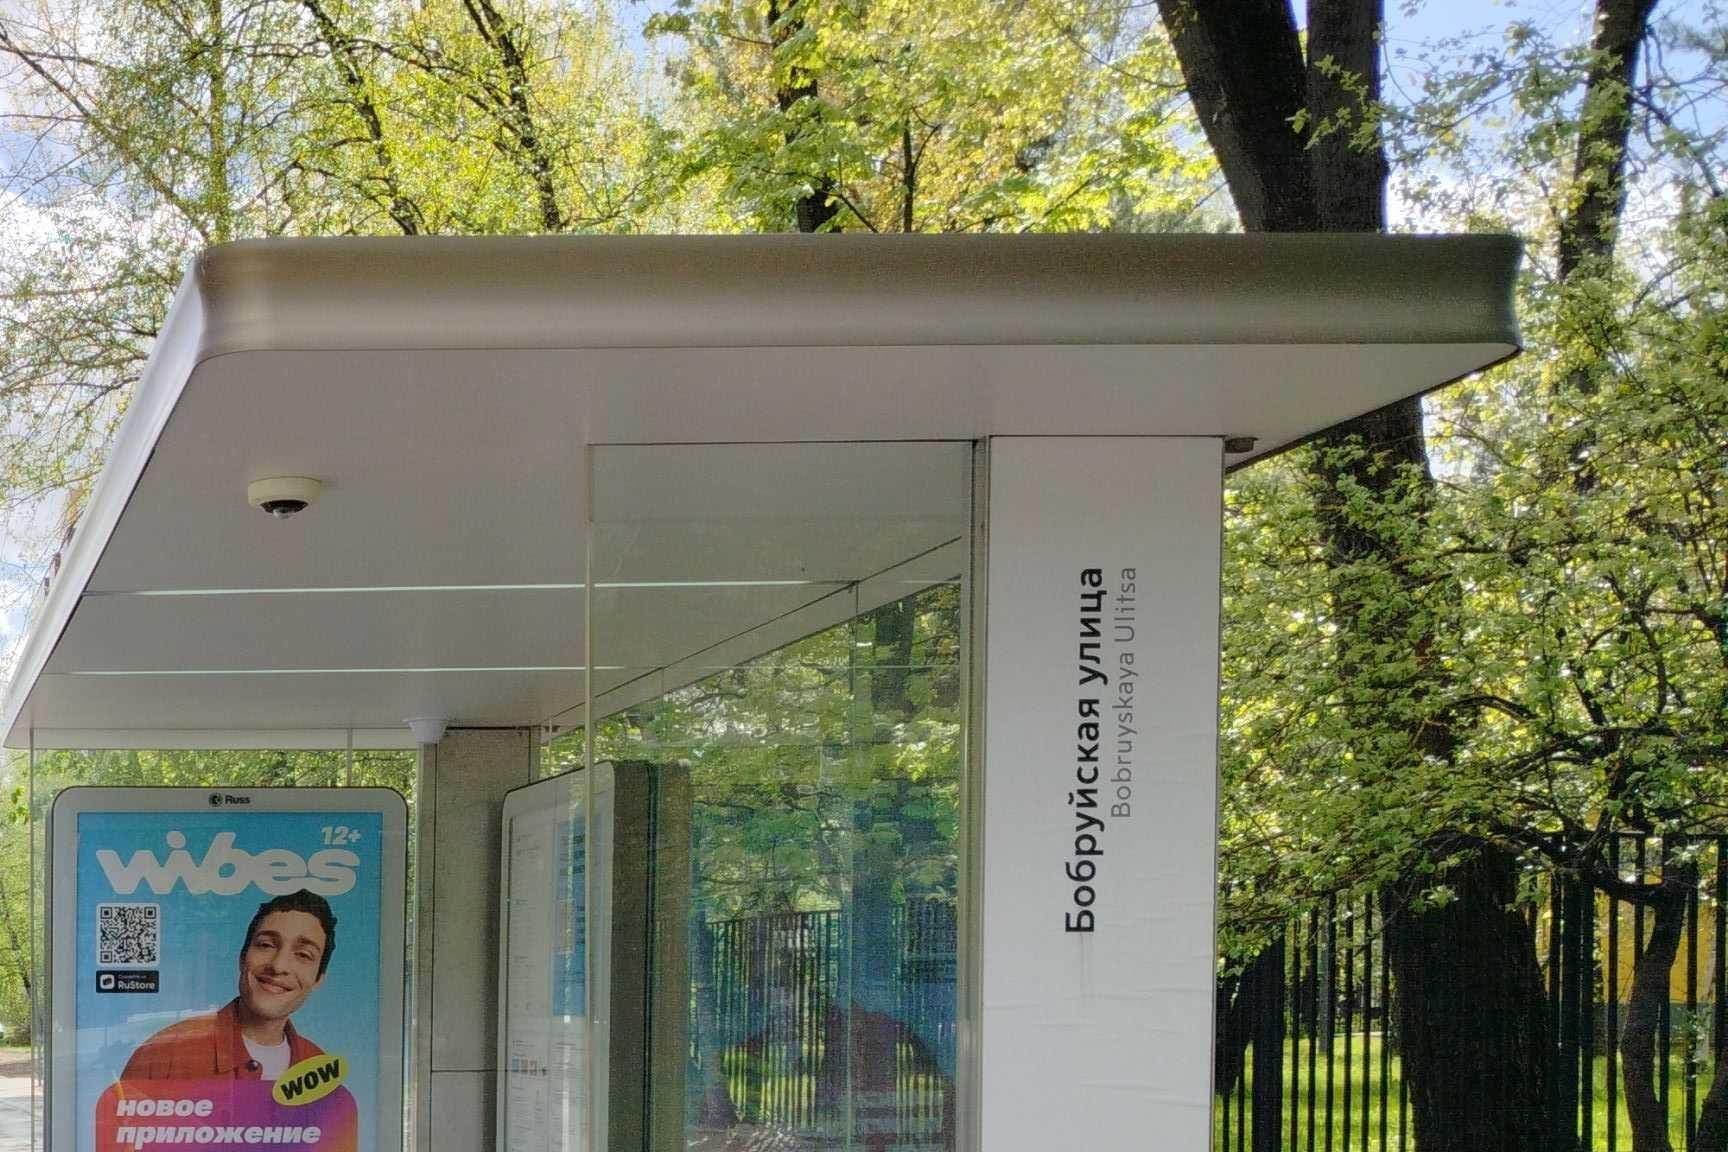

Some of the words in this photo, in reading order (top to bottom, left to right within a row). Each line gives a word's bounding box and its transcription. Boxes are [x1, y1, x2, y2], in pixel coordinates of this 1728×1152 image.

[1079, 568, 1108, 685] улица
[1114, 567, 1137, 642] Ulitsa
[1111, 652, 1138, 817] Bobruyskaya
[322, 826, 362, 845] 12+
[1065, 699, 1105, 932] Бобруйская
[95, 830, 361, 896] wibes
[116, 1099, 214, 1117] новое
[116, 1125, 322, 1150] приложение
